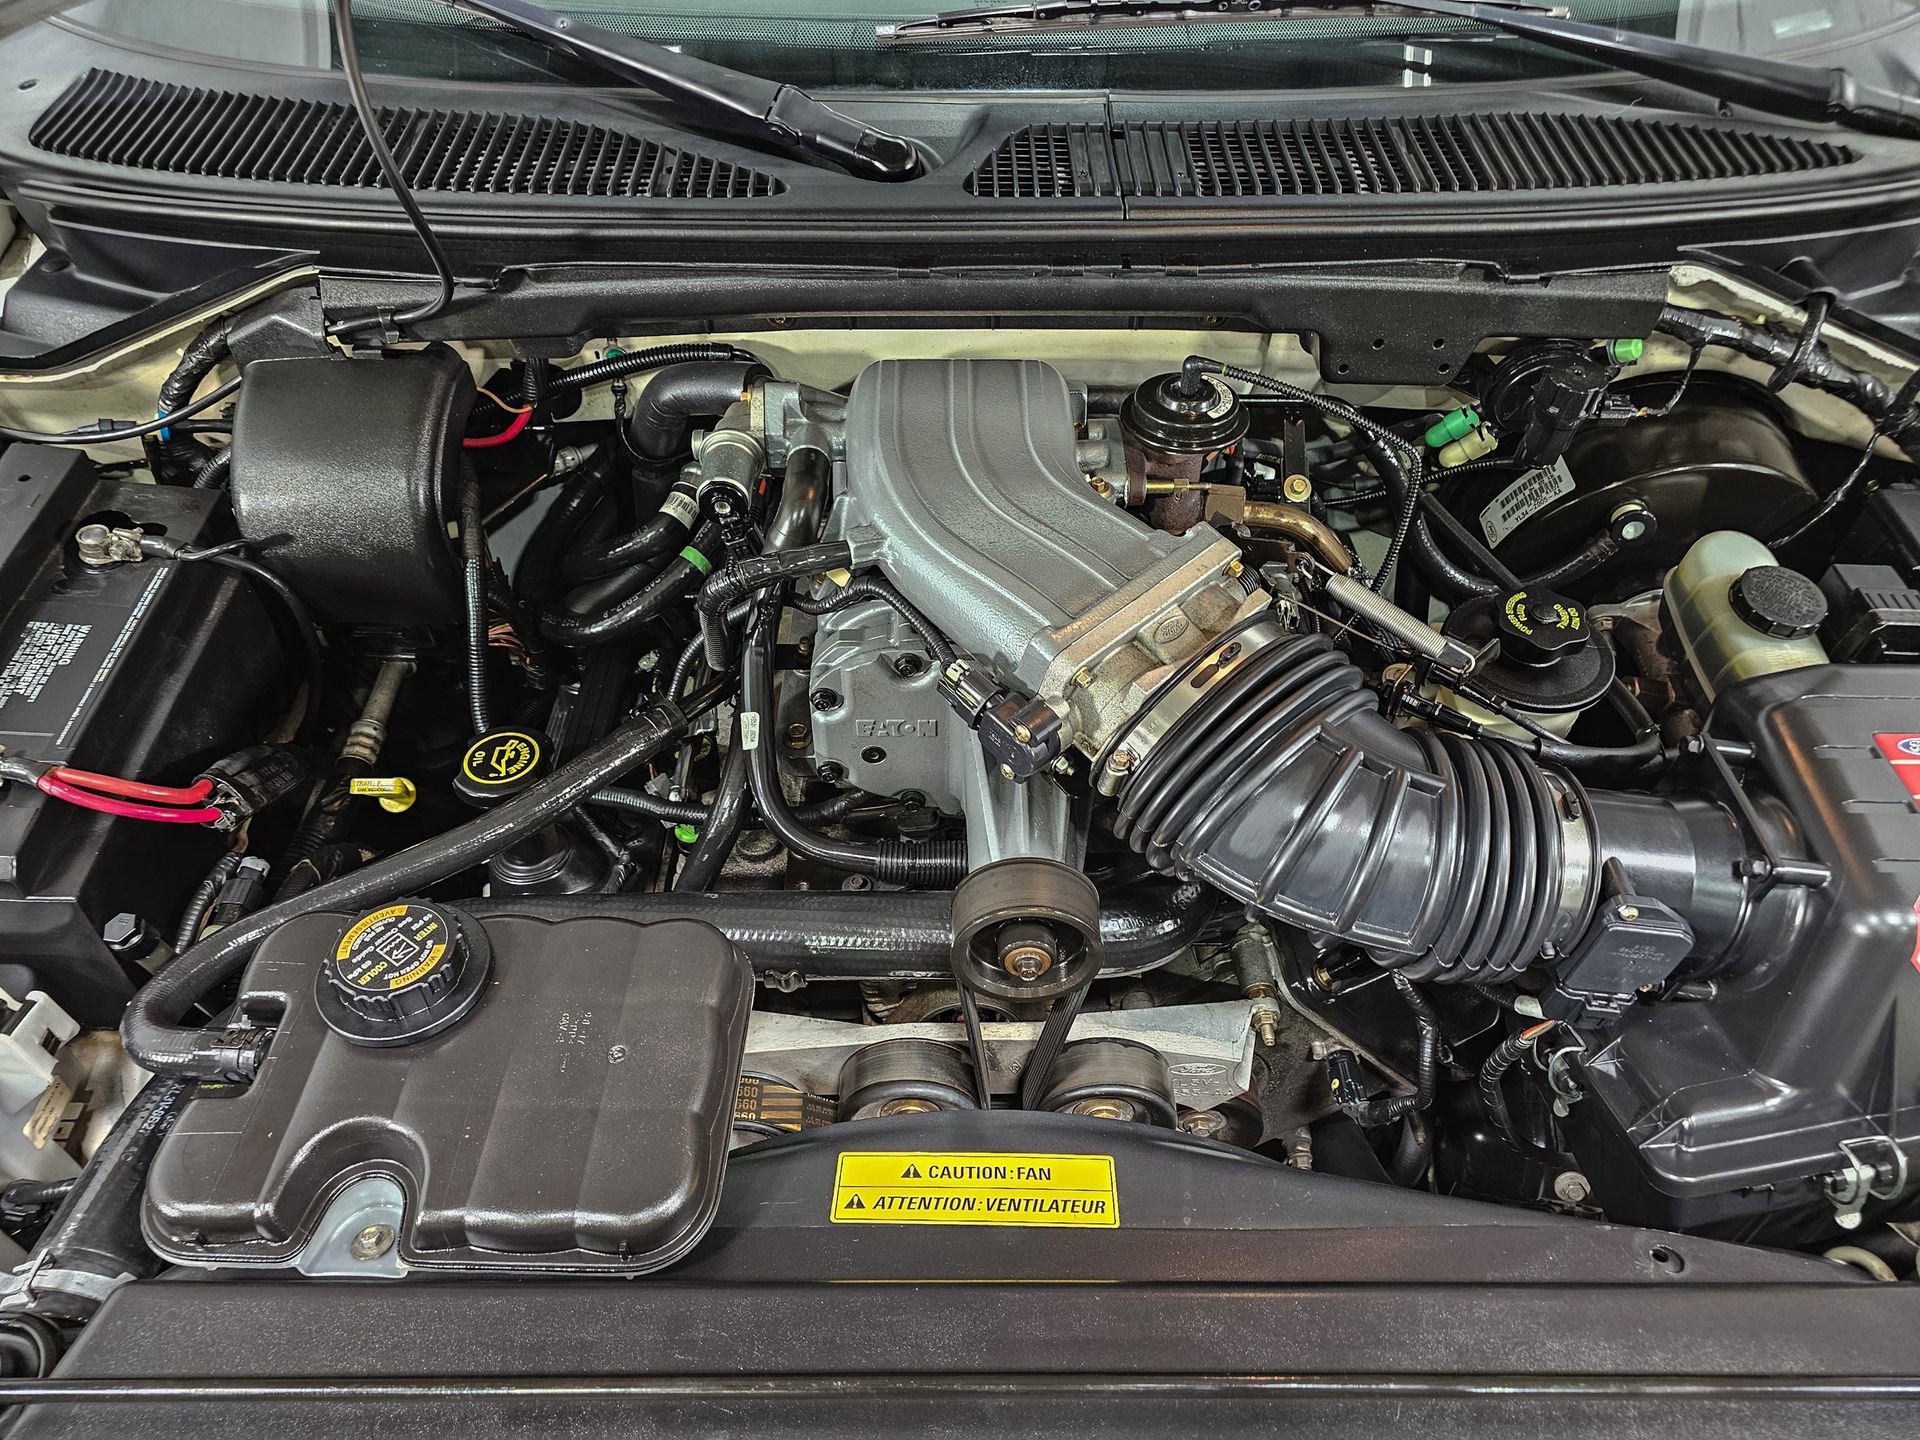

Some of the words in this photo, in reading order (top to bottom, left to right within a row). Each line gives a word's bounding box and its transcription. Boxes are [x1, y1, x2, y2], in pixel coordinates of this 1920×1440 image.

[58, 624, 92, 665] WARNING
[14, 623, 64, 695] AVERTISSEMENT
[856, 720, 938, 736] EATON
[472, 751, 486, 767] OIL
[507, 742, 531, 775] ENGINE
[340, 908, 396, 953] AVERTISSEMENT
[414, 922, 438, 942] INTER
[358, 961, 388, 985] COOLER
[395, 957, 434, 985] WARNING
